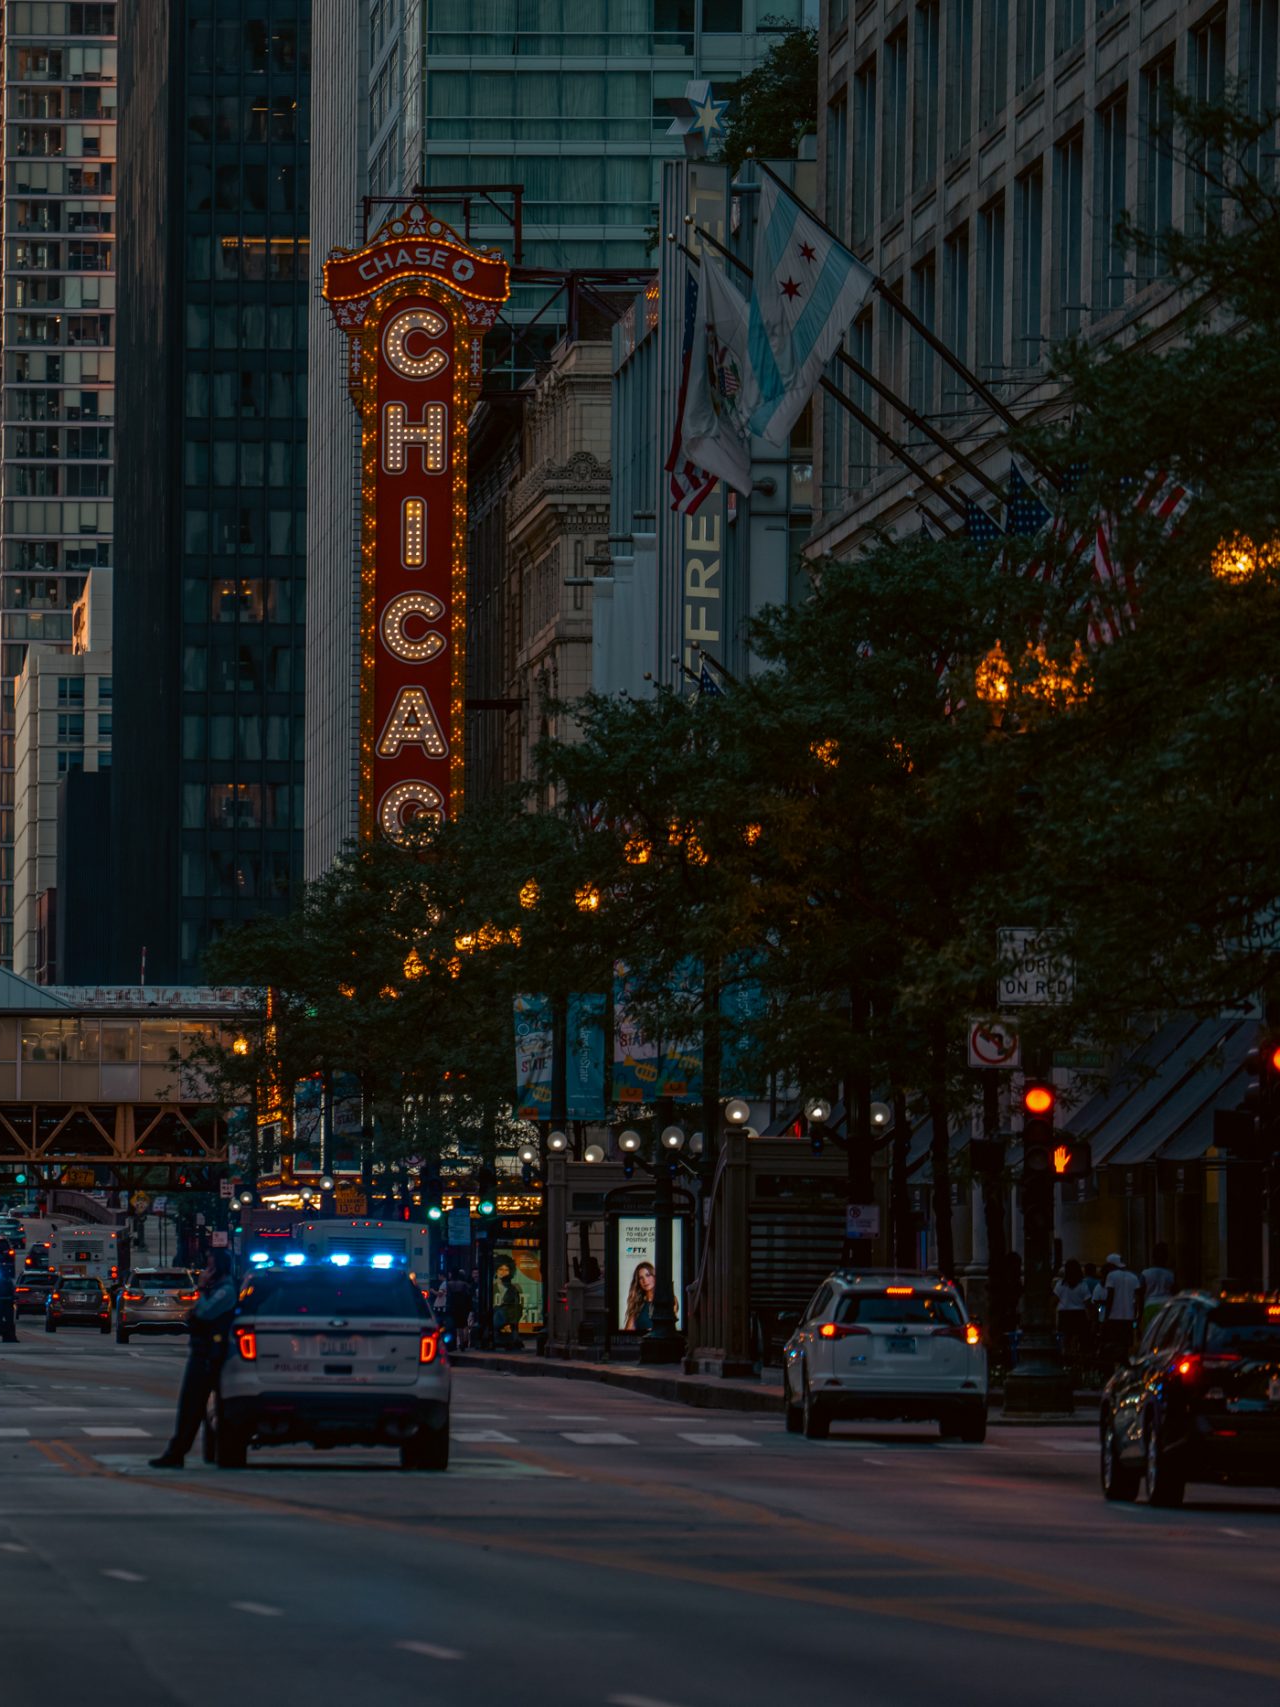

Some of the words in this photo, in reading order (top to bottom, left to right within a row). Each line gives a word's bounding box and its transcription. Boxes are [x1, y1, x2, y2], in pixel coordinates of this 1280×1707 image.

[358, 247, 449, 281] CHASE
[376, 306, 449, 853] CHICAG
[1005, 980, 1028, 994] ON
[1035, 980, 1068, 994] RED
